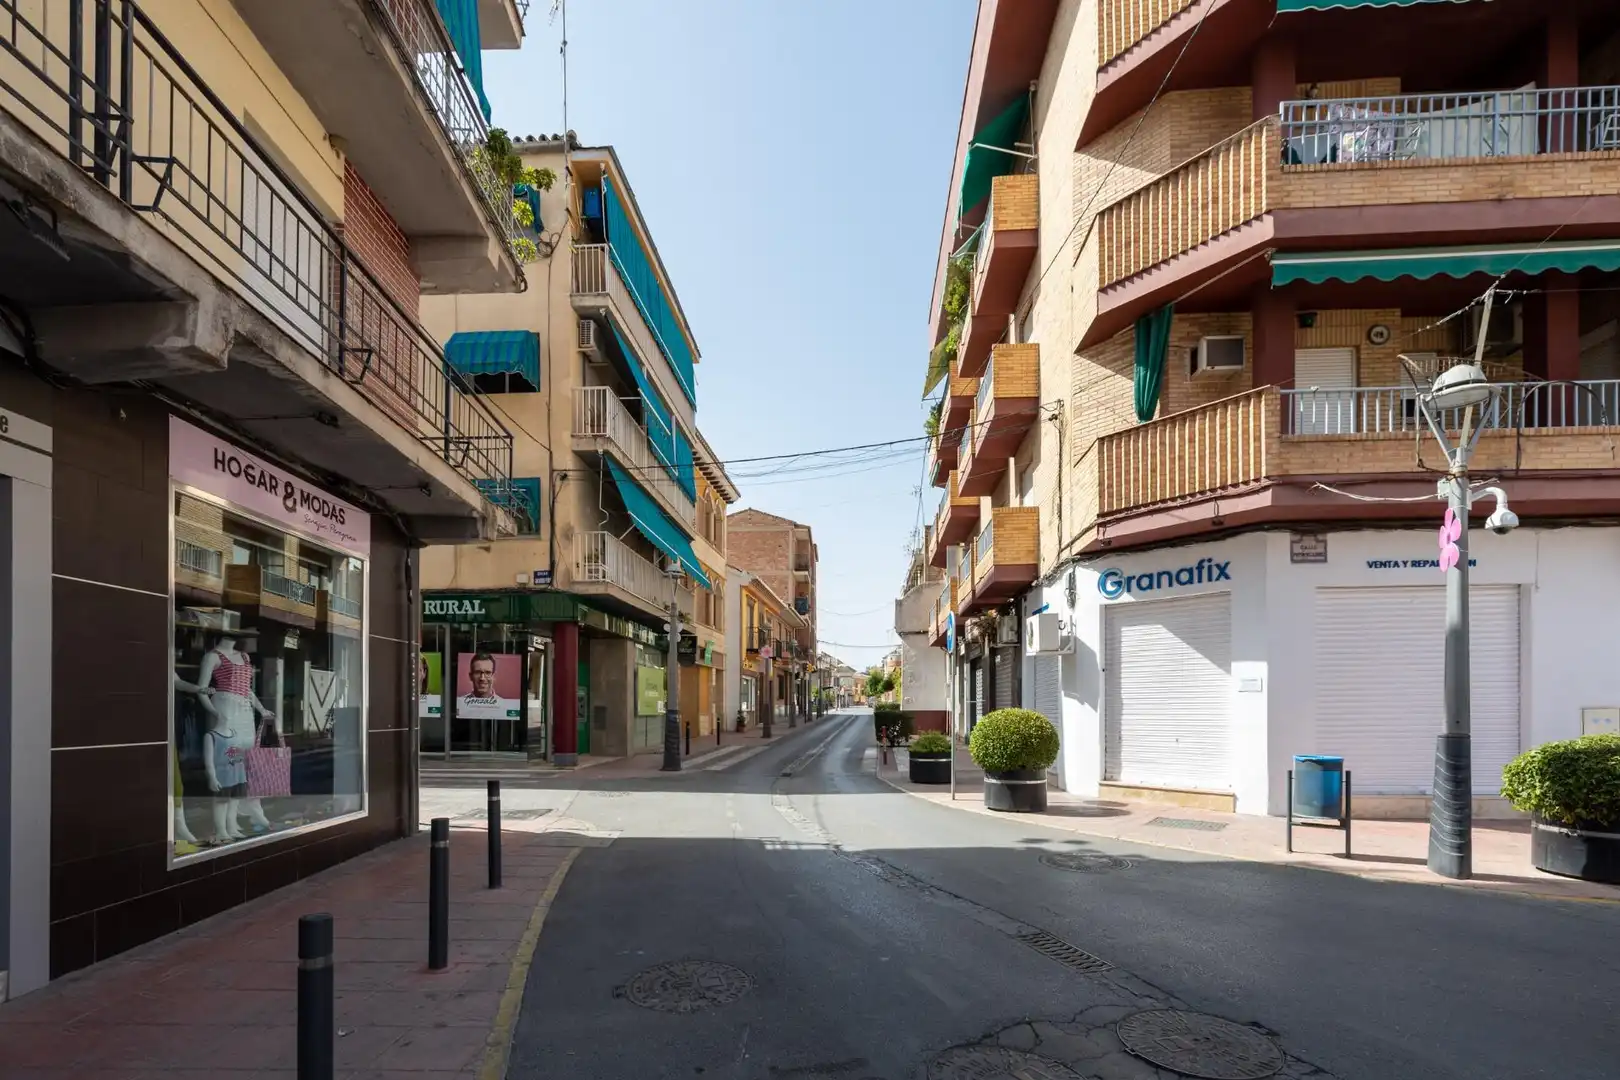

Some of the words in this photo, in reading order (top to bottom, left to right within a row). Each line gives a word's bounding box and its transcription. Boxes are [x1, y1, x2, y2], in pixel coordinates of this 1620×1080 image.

[213, 447, 279, 497] HOGAR
[282, 481, 297, 513] &
[300, 488, 346, 525] MODAS
[1098, 557, 1231, 600] Granafix
[1366, 560, 1400, 569] VENTA
[1402, 560, 1408, 568] Y
[423, 599, 486, 615] RURAL
